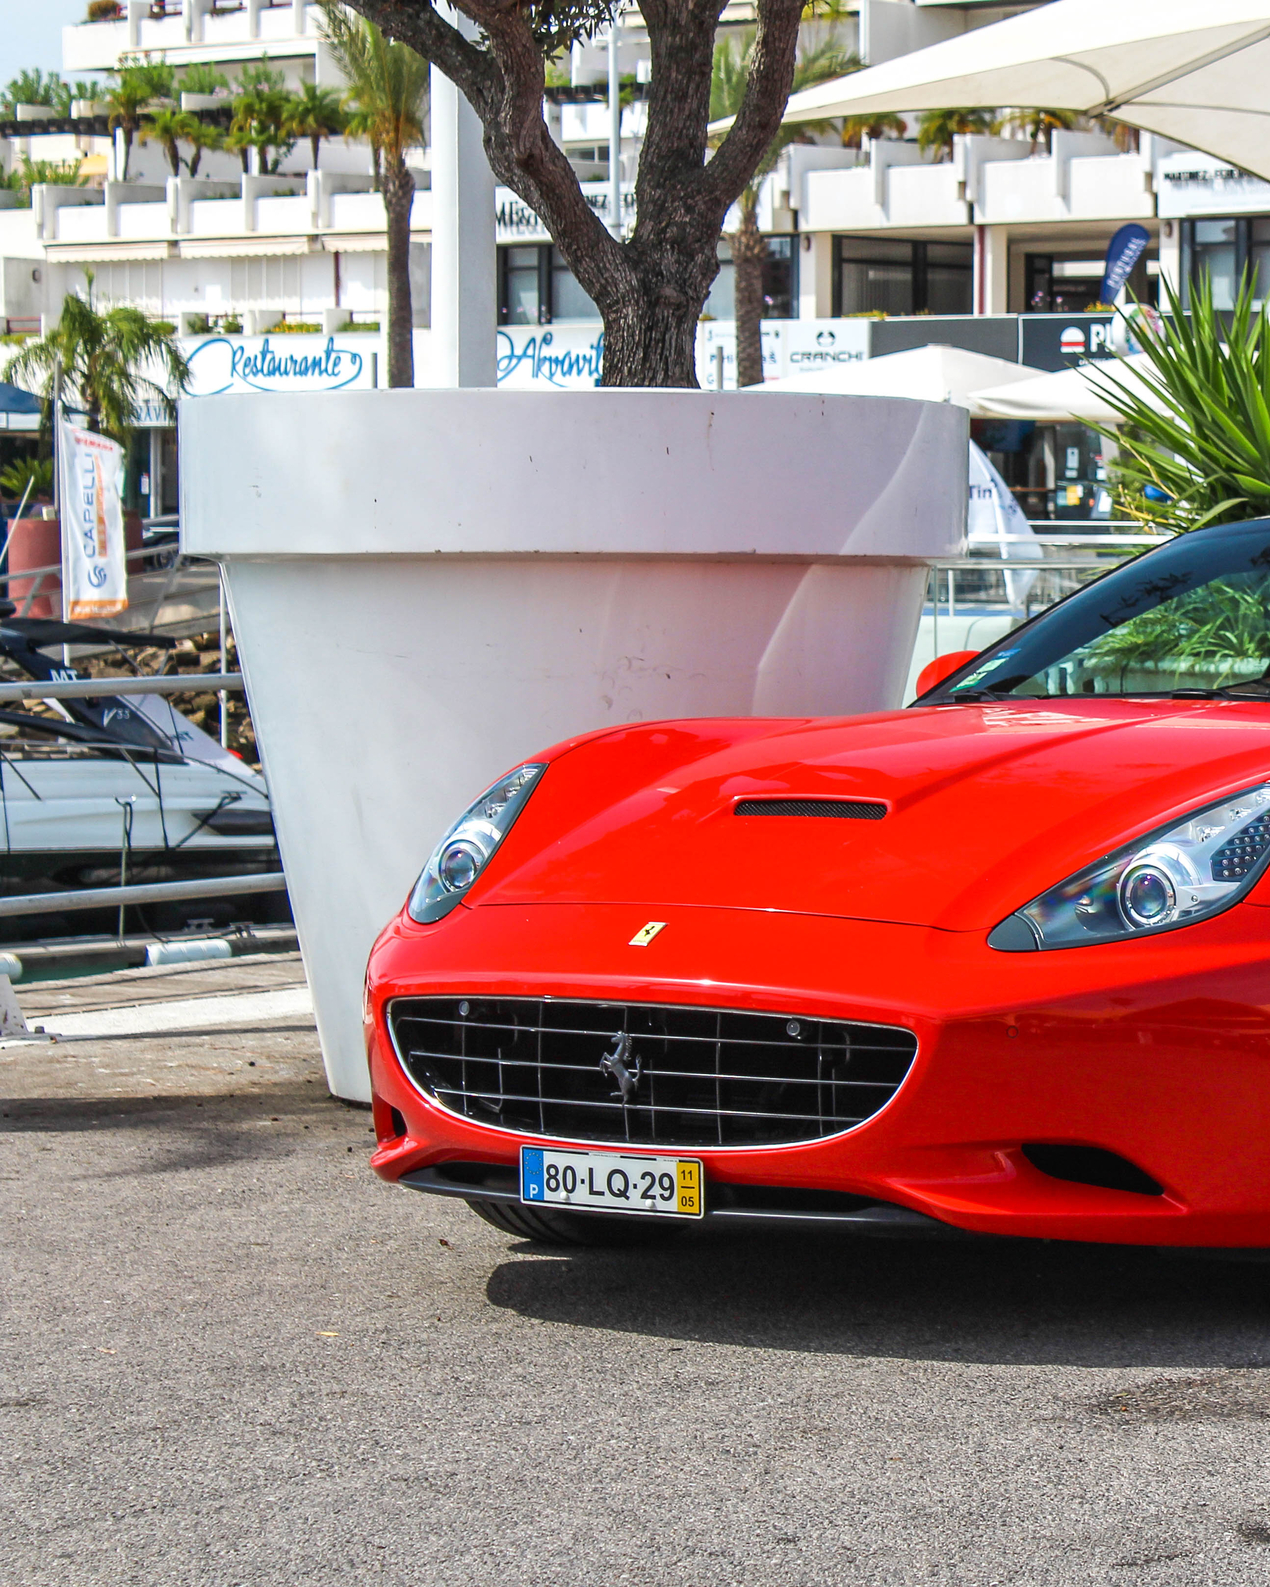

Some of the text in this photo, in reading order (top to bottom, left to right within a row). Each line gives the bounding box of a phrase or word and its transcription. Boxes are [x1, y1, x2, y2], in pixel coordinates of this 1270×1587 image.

[222, 336, 352, 384] Restaurante
[790, 351, 864, 363] CRANCHI
[83, 453, 95, 558] CAPELLI
[680, 1169, 693, 1181] 11
[529, 1183, 695, 1208] P 05
